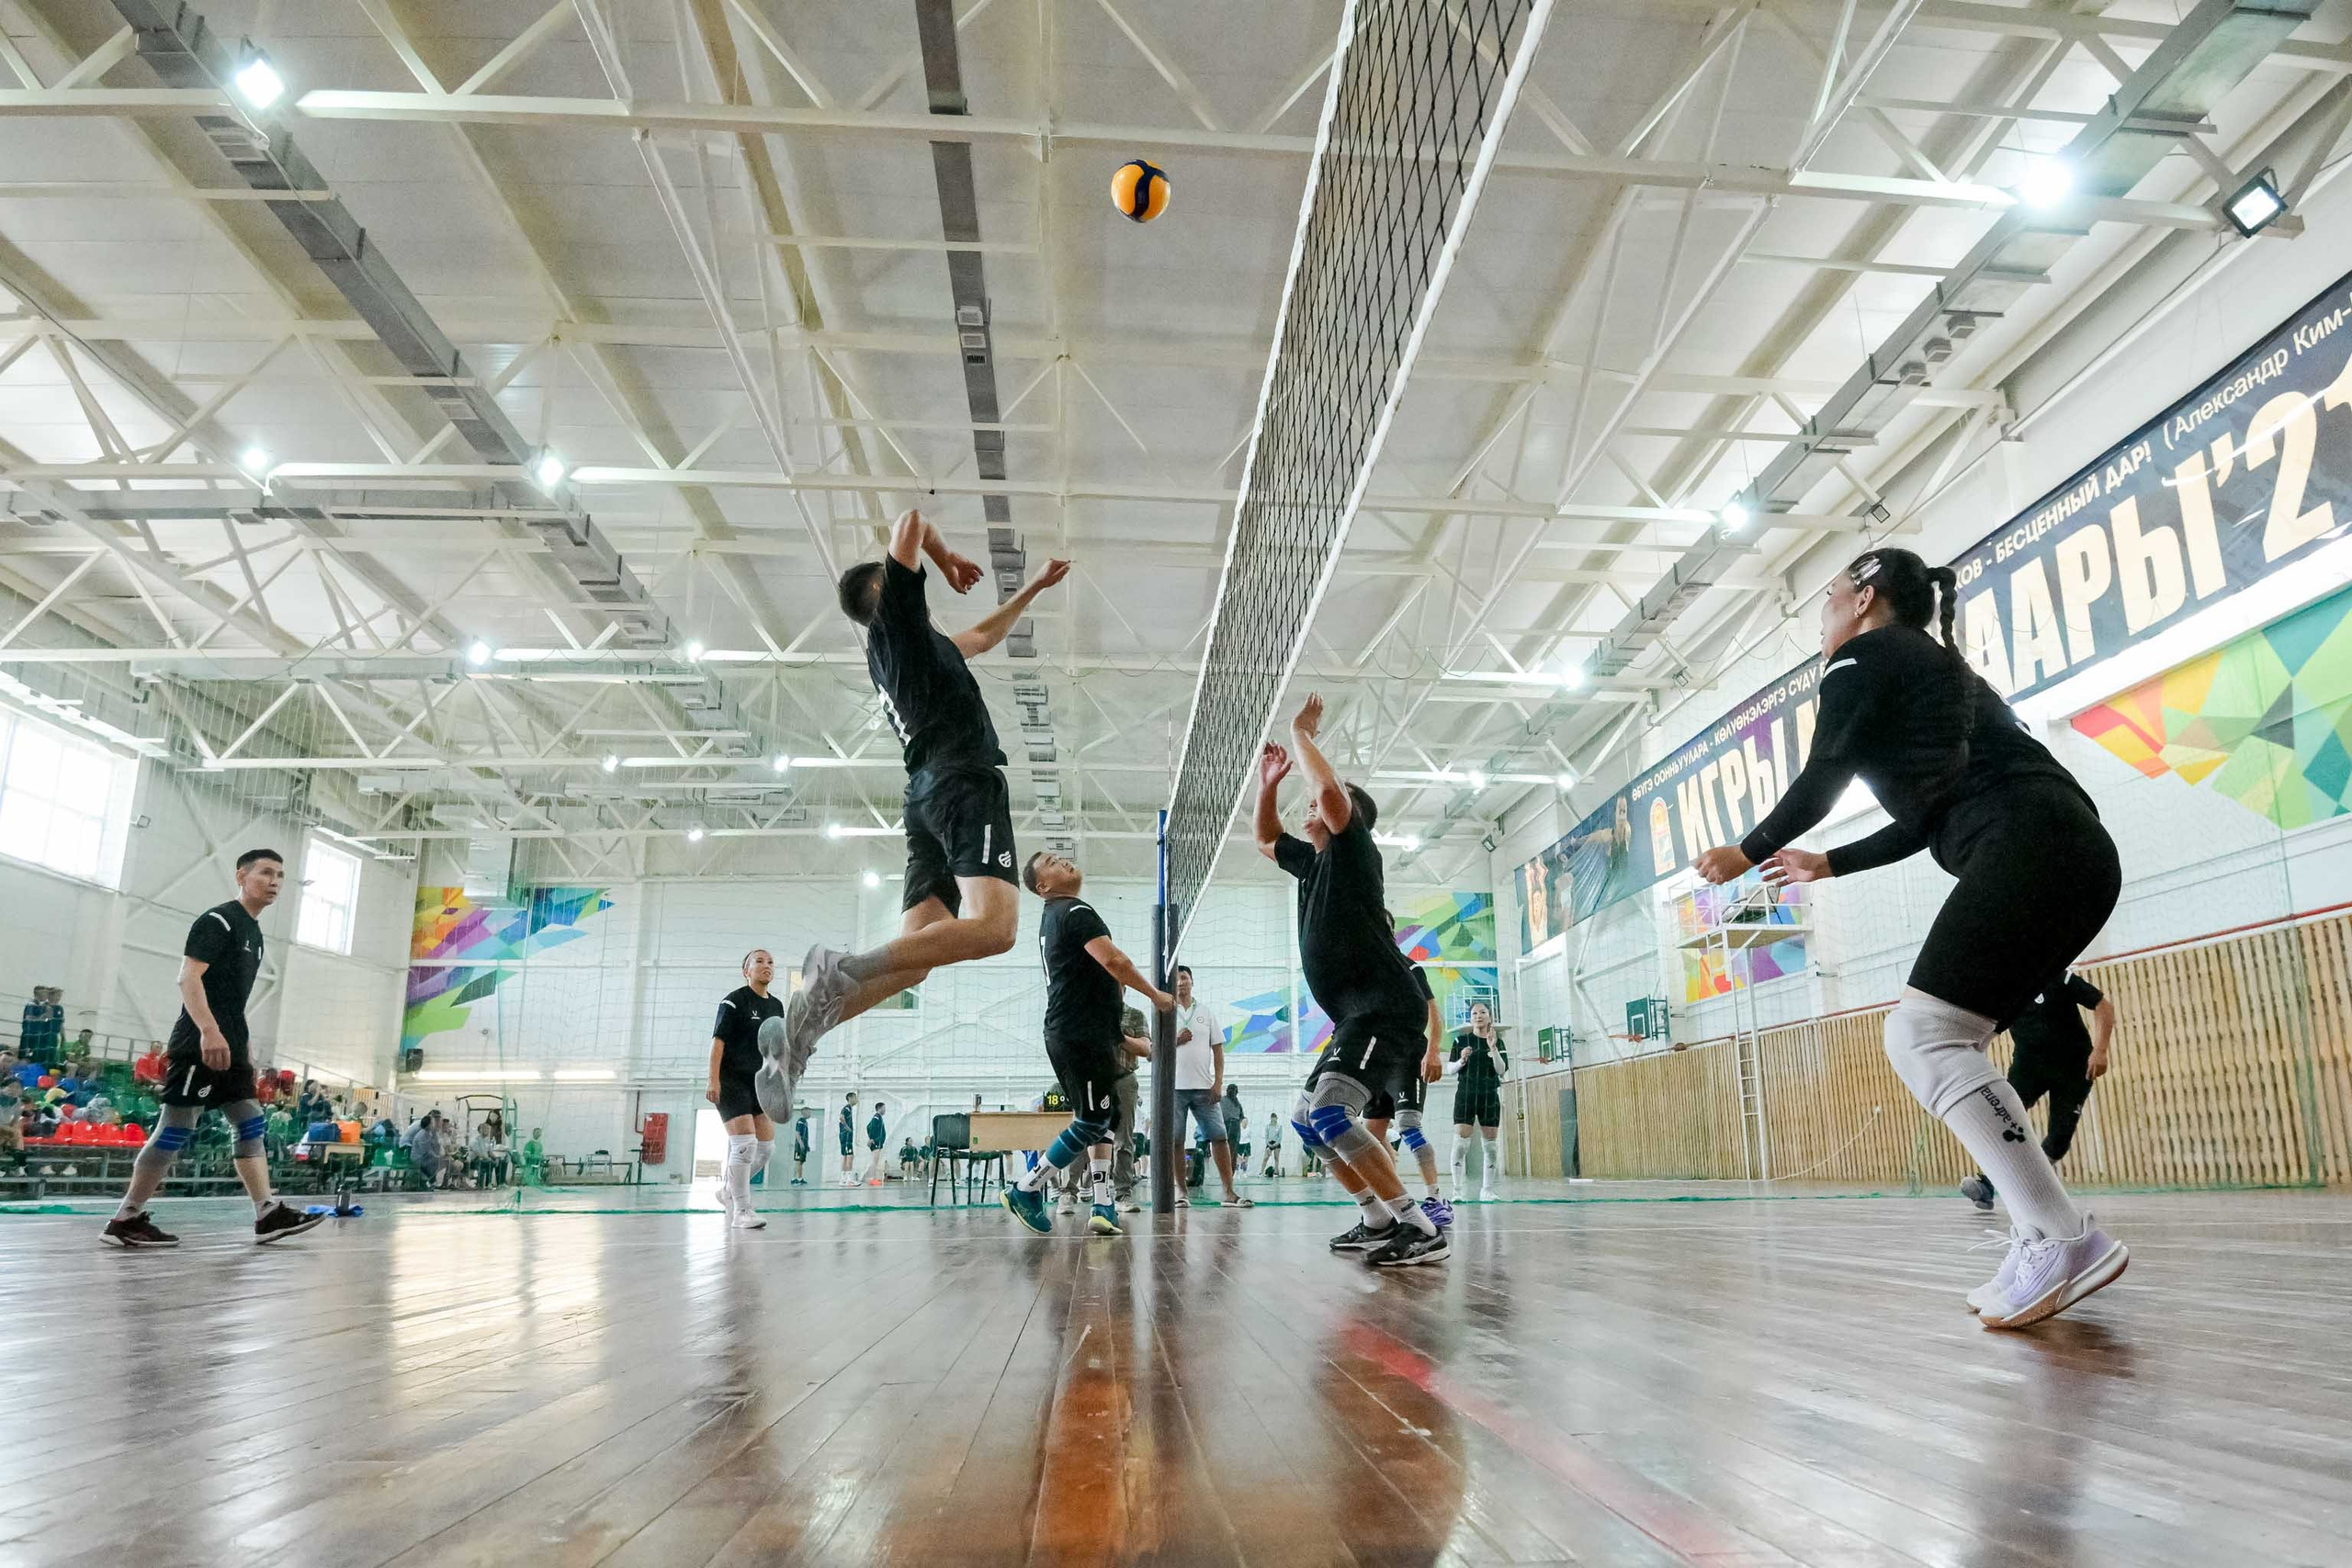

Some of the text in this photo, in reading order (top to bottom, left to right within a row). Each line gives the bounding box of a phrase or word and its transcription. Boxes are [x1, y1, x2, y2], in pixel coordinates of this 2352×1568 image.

[1996, 473, 2100, 564] БЕСЦЕННЫЙ
[2105, 440, 2153, 495] ДАР!
[2163, 348, 2290, 451] (Александр
[2293, 292, 2352, 355] Ким-
[1677, 716, 1790, 862] ИГРЫ
[1047, 1094, 1058, 1105] 18
